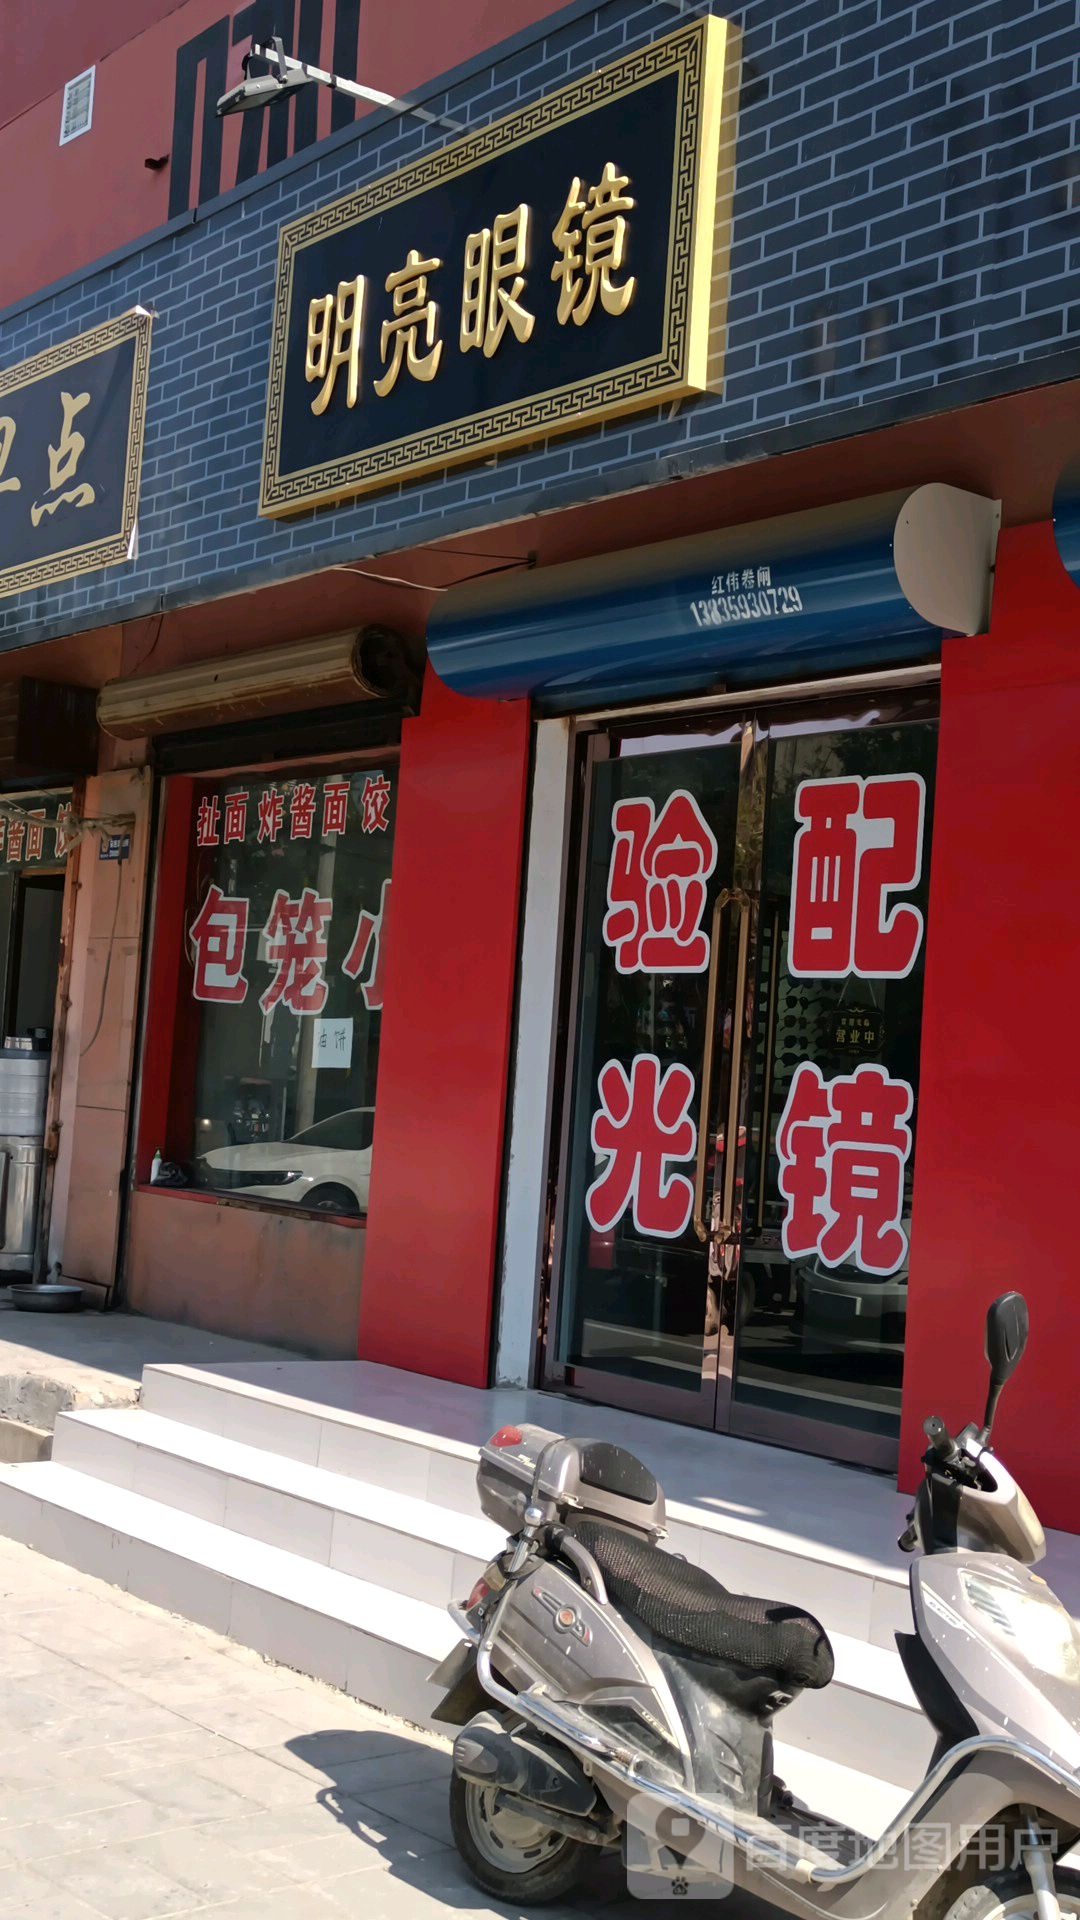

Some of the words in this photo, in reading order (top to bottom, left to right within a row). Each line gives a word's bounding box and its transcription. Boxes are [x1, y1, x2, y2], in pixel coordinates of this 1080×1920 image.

[305, 162, 636, 416] 明亮眼镜
[690, 585, 803, 626] 13835930729
[836, 1029, 875, 1044] 营业中
